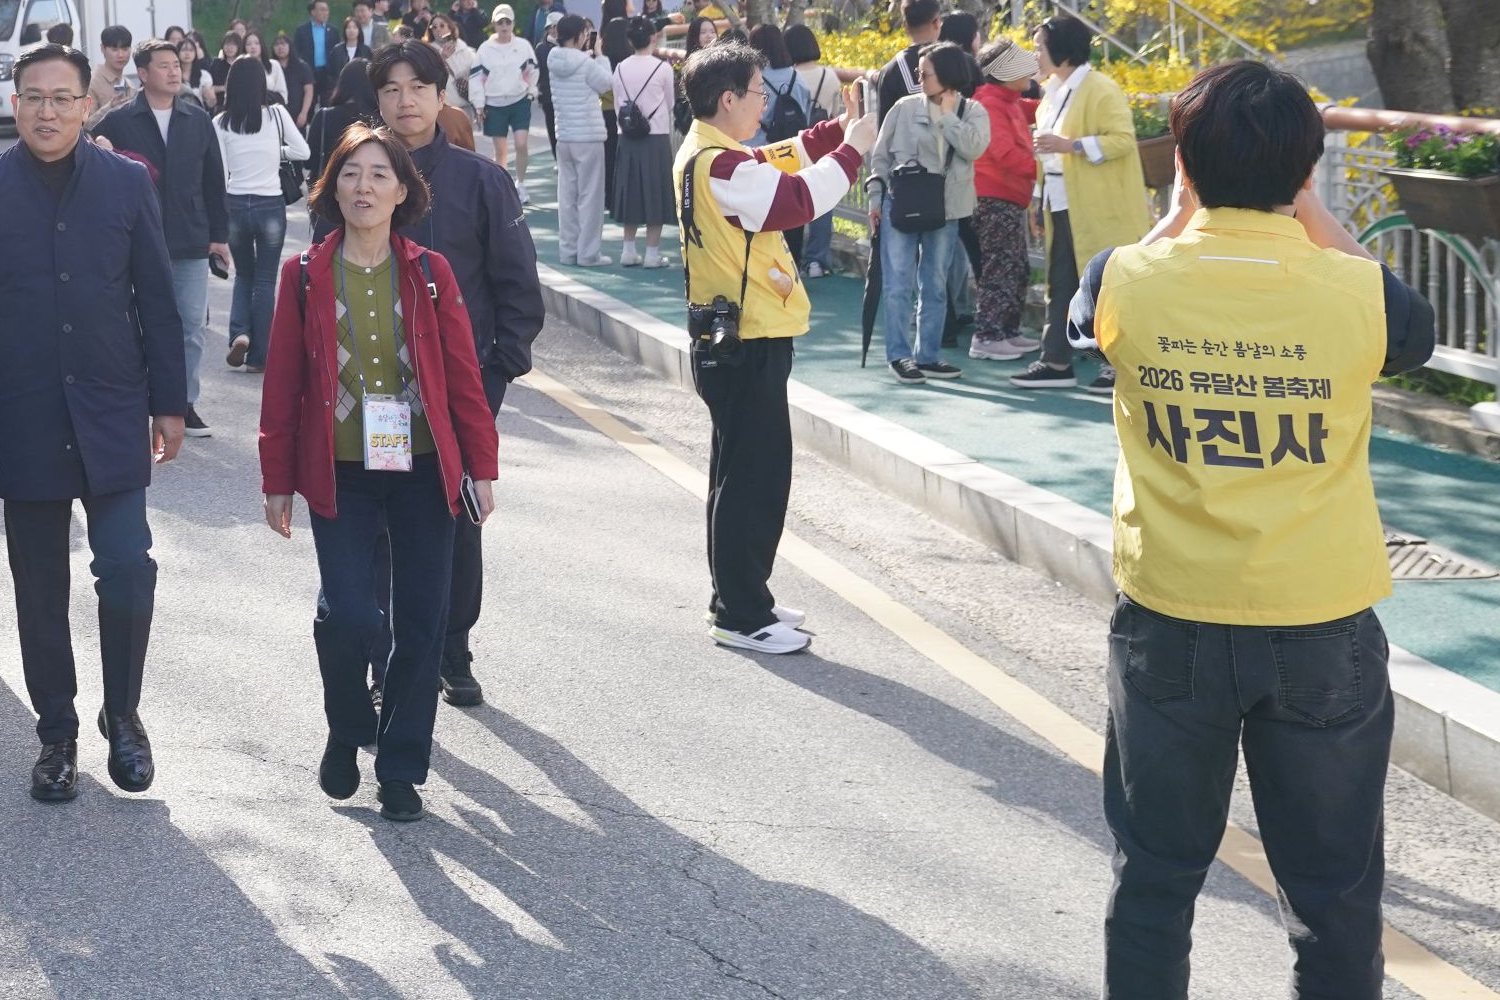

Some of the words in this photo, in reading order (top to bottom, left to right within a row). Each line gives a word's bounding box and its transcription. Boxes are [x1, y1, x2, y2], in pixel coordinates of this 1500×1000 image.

[1157, 336, 1198, 354] 꽃피는
[1201, 338, 1229, 358] 순간
[1232, 340, 1276, 360] 봄날의
[1279, 344, 1308, 361] 소풍
[1137, 365, 1184, 392] 2026
[1189, 371, 1258, 398] 유달산
[1262, 375, 1332, 400] 봄축제
[370, 433, 409, 448] STAFF
[1142, 400, 1329, 470] 사진사
